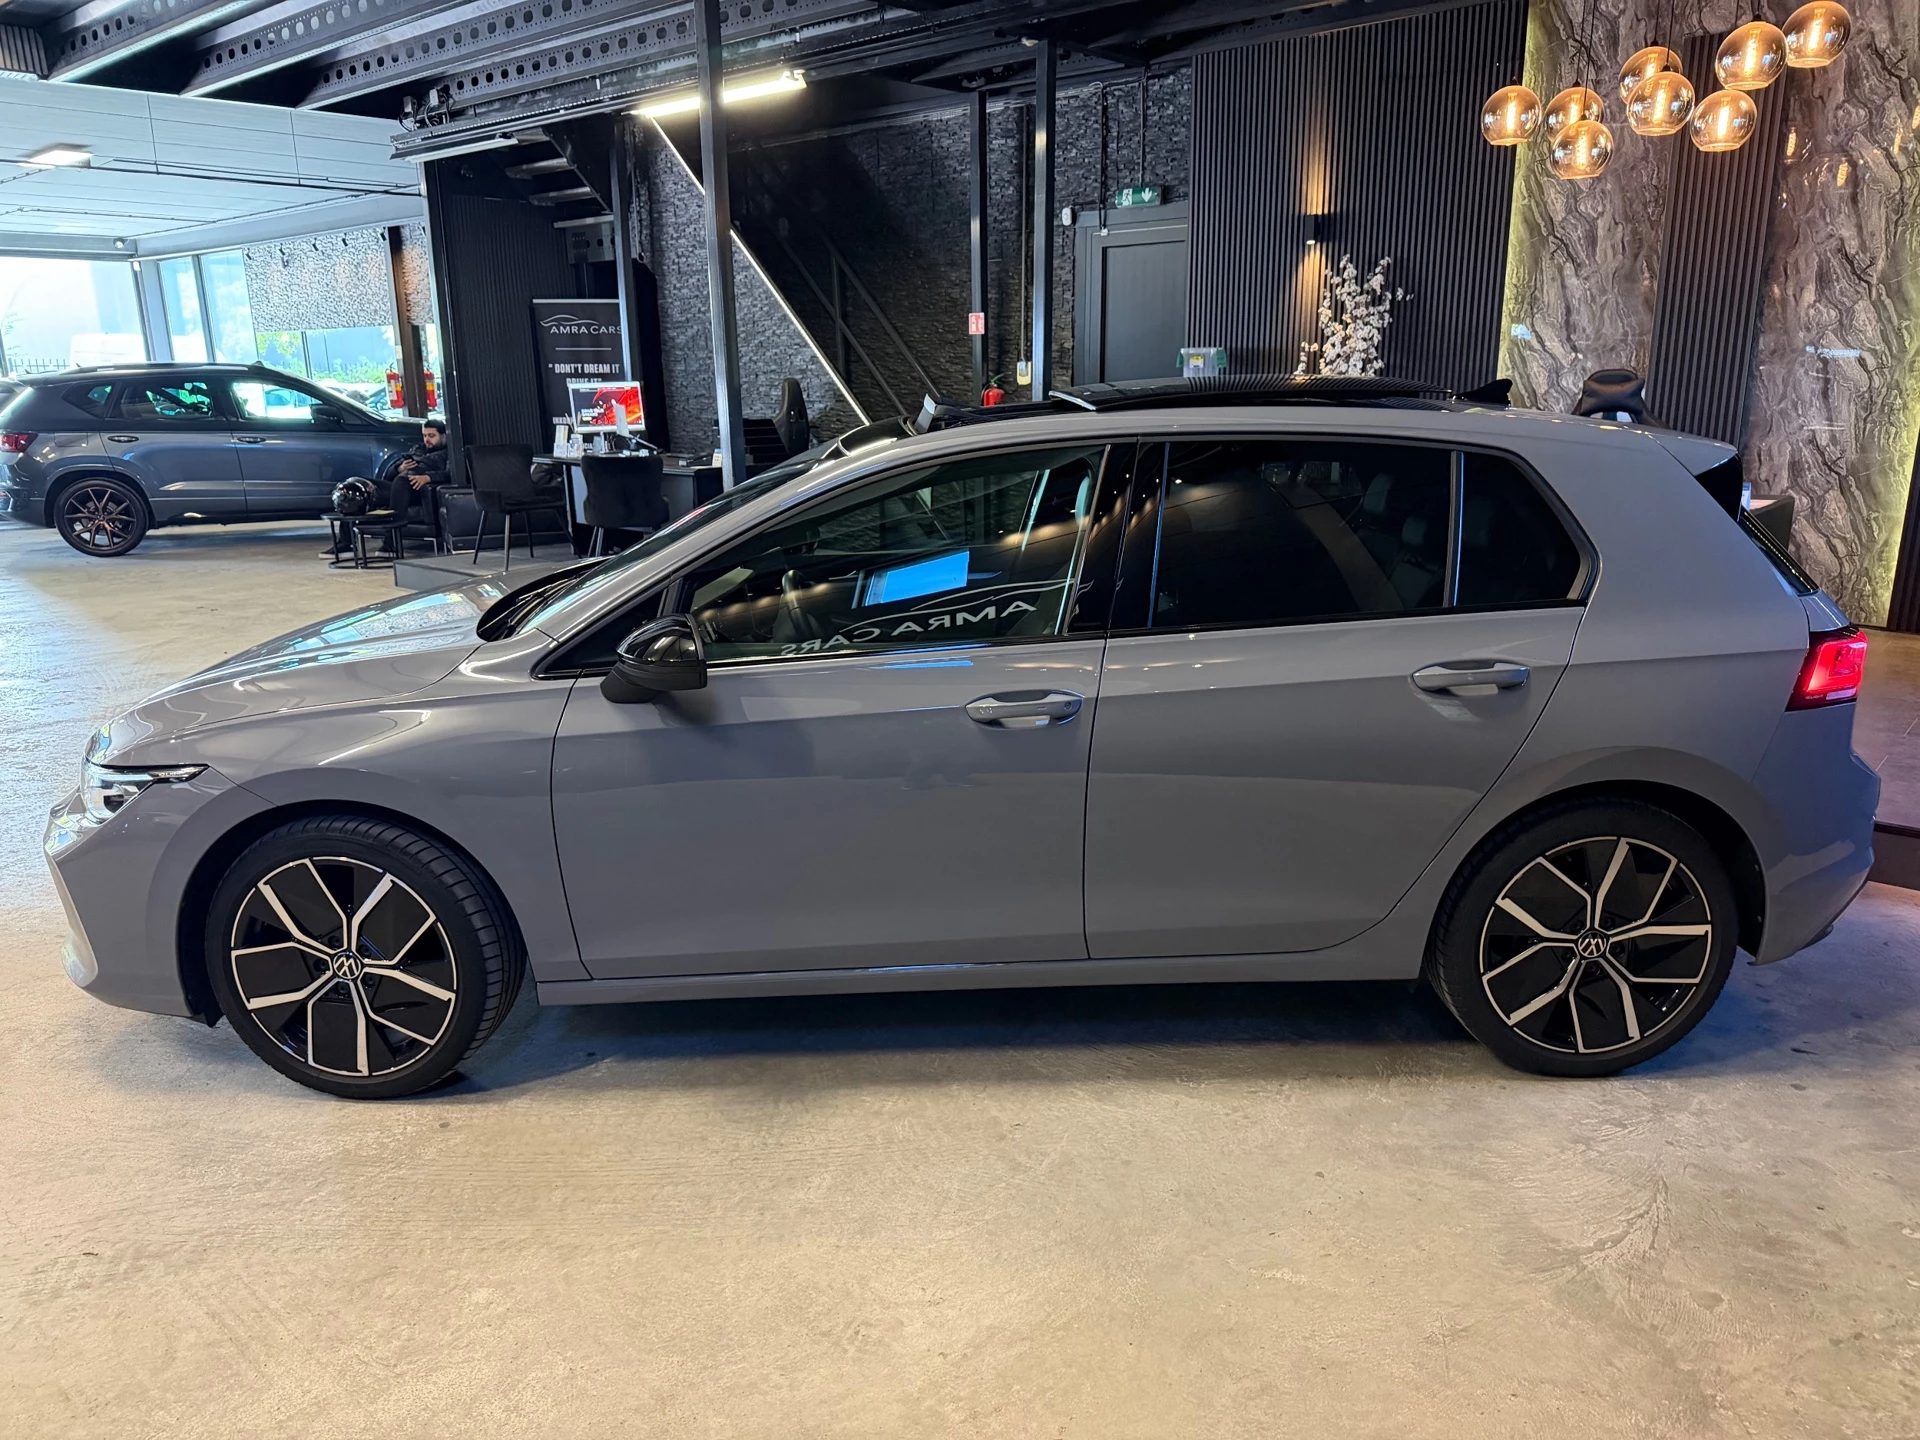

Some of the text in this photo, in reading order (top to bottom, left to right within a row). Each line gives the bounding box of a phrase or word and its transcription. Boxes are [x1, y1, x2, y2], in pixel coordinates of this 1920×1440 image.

[550, 325, 622, 335] AMRA CARS
[583, 363, 611, 374] DREAM
[611, 363, 620, 374] IT
